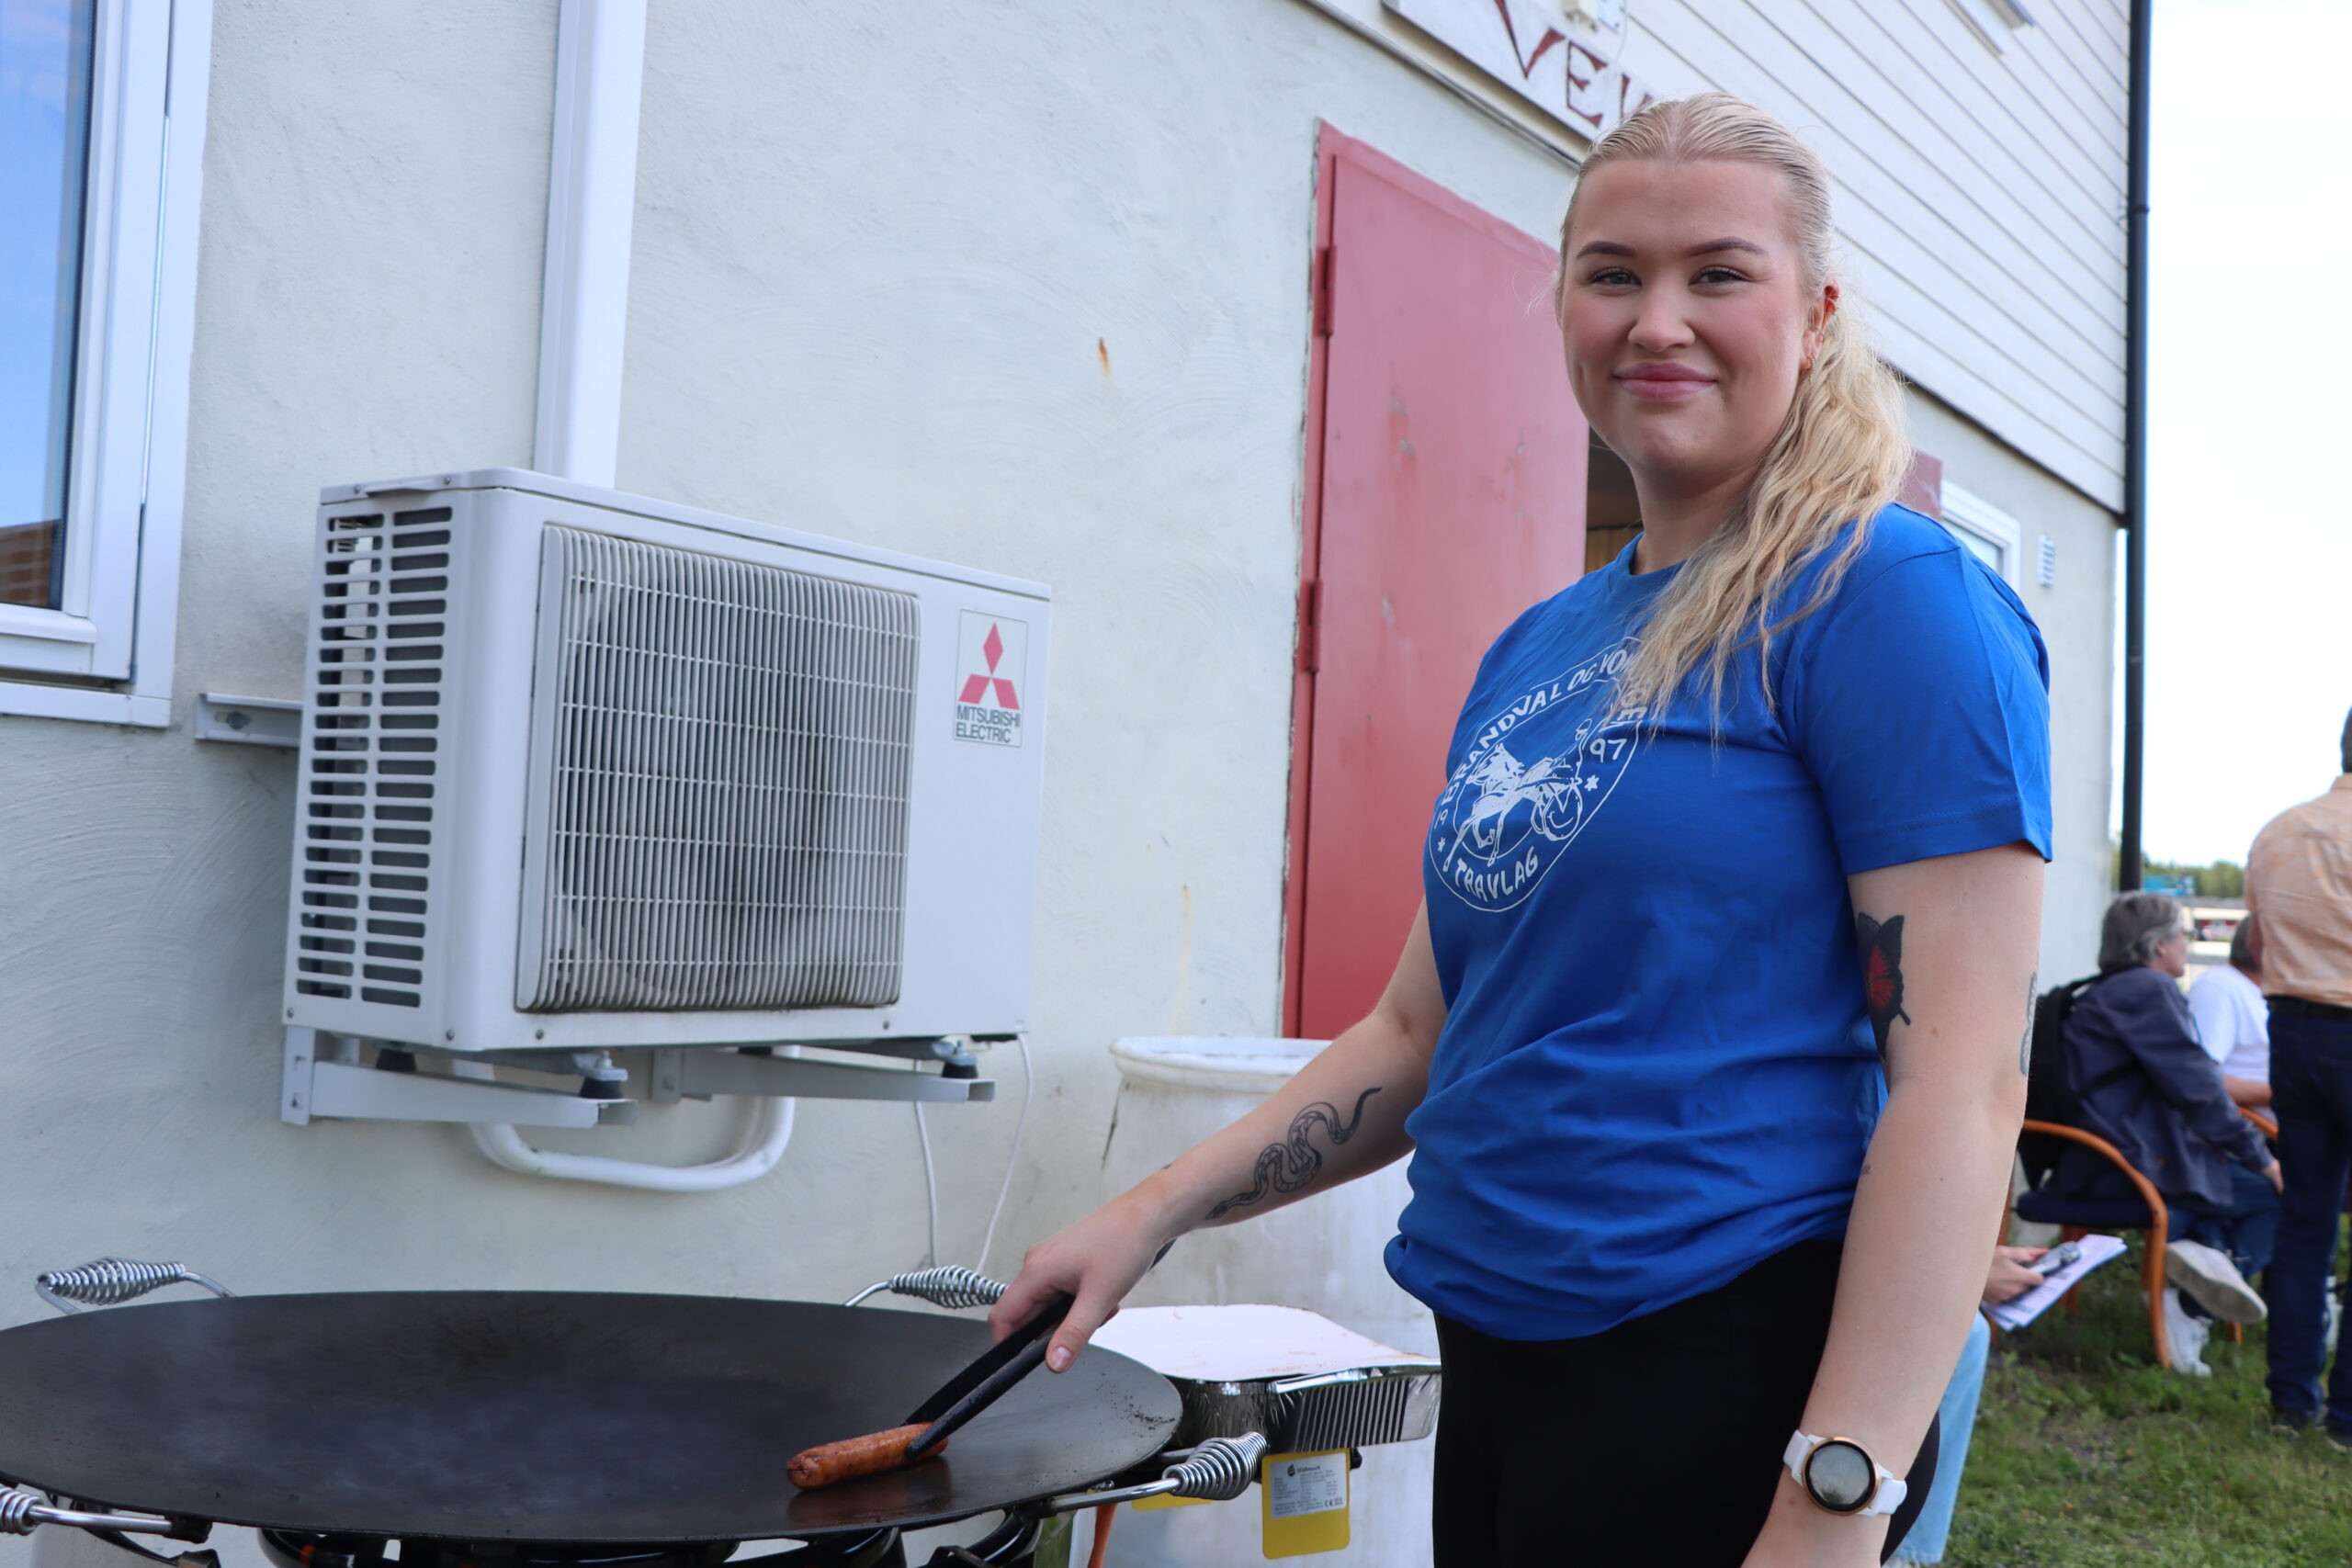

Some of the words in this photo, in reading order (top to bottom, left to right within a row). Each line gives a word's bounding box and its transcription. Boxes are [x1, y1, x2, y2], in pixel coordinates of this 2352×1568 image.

[956, 705, 1021, 728] MITSUBISHI
[956, 722, 1011, 743] ELECTRIC
[1441, 682, 1562, 806] BRANDVAL
[1567, 662, 1597, 691] OG
[1589, 738, 1627, 763] 97
[1454, 846, 1538, 902] TRAVLAG
